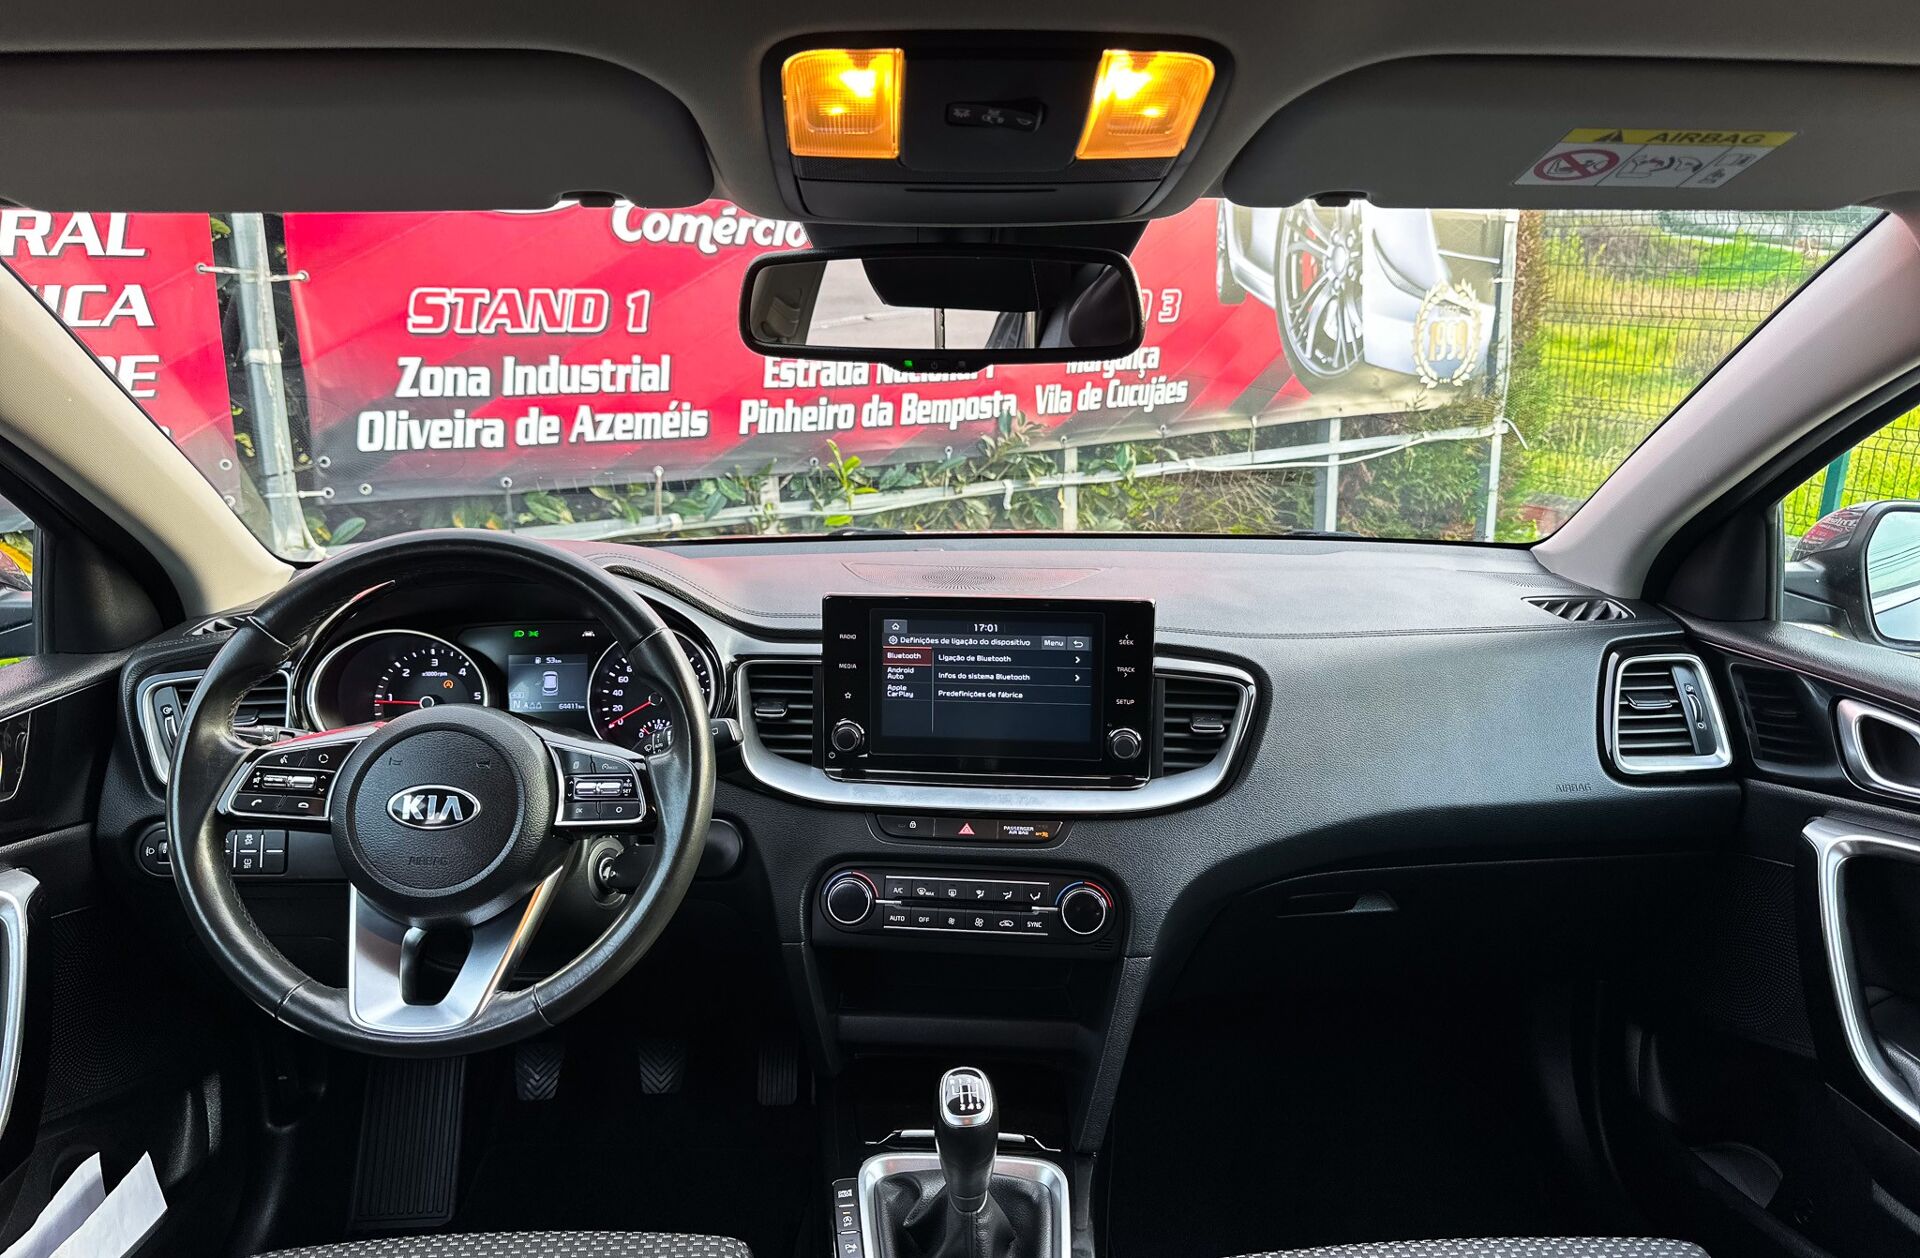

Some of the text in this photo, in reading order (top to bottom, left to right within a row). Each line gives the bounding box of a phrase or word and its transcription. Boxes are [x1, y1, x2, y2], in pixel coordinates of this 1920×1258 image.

[1646, 131, 1766, 144] AIRBAG
[0, 211, 147, 257] RAL
[30, 284, 155, 327] ICA
[1157, 288, 1183, 323] 3
[406, 286, 652, 335] STAND 1
[395, 354, 671, 398] Zona Industrial
[762, 356, 869, 389] Estrada
[1035, 375, 1189, 415] Vila de Cucujães
[738, 390, 1017, 435] Pinheiro da Bemposta
[356, 400, 709, 452] Oliveira de Azeméis
[974, 623, 998, 632] 17:01
[900, 636, 939, 645] Definições
[940, 637, 950, 645] de
[951, 637, 978, 646] ligação
[990, 638, 1031, 646] dispositivo
[1043, 639, 1064, 647] Menu
[887, 651, 922, 659] Bluetooth
[938, 654, 965, 662] Ligação
[976, 654, 1012, 662] Bluetooth
[431, 658, 439, 667] 3
[402, 668, 411, 677] 2
[458, 667, 467, 676] 4
[887, 666, 915, 674] Android
[617, 675, 629, 683] 60
[387, 693, 393, 701] 1
[474, 692, 481, 700] 5
[612, 689, 623, 697] 40
[887, 690, 914, 698] CarPlay
[938, 690, 986, 698] Predefinições
[997, 691, 1023, 699] fábrica
[612, 704, 623, 712] 20
[1555, 783, 1592, 793] AIRBAG
[401, 793, 464, 821] KIA
